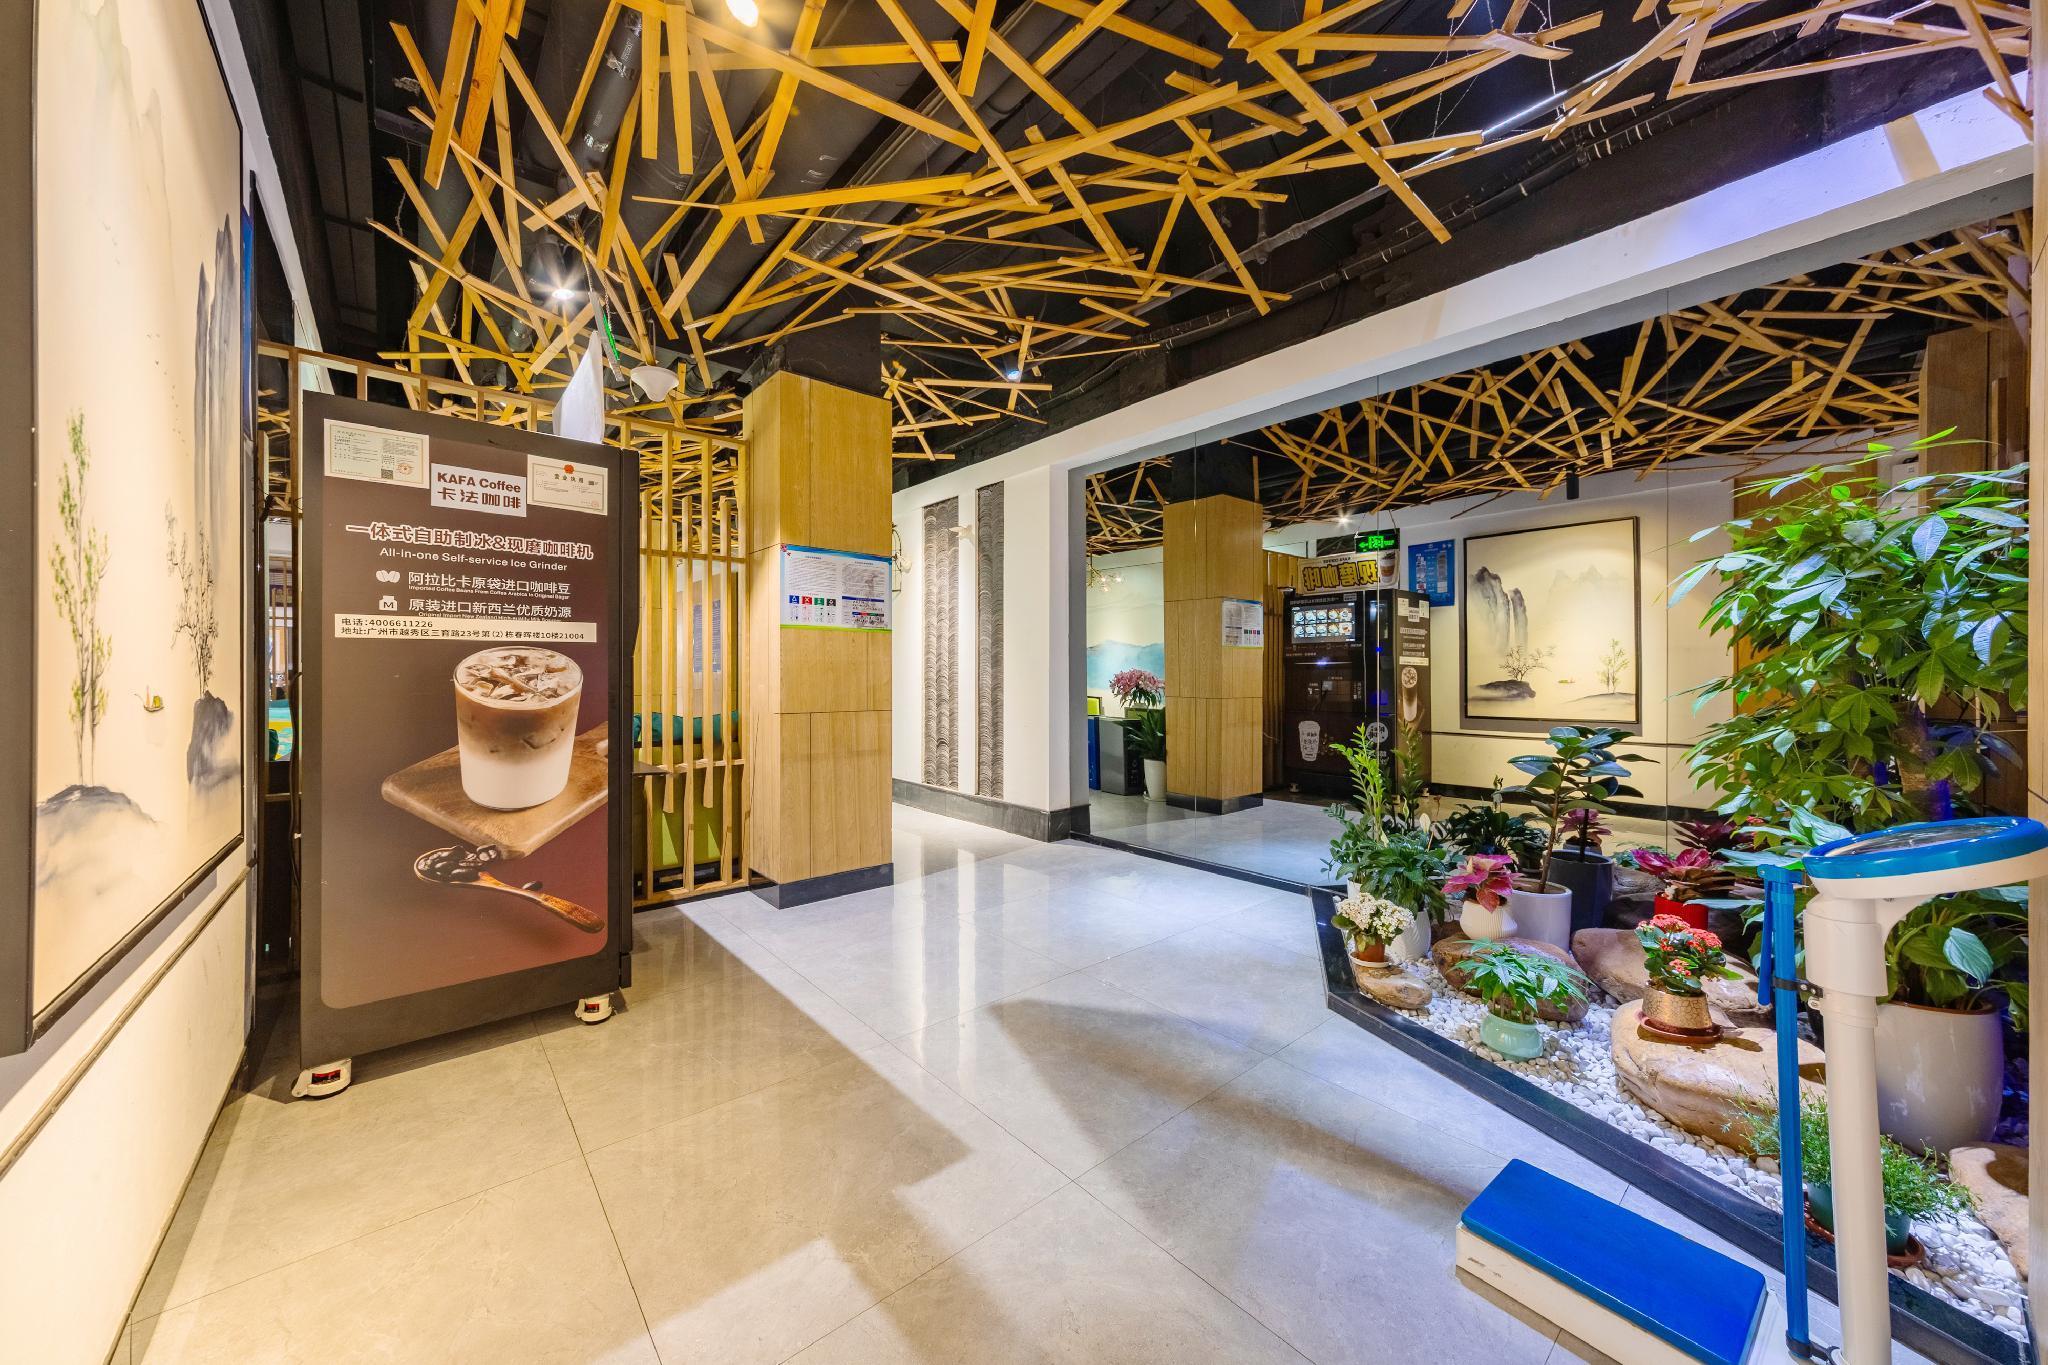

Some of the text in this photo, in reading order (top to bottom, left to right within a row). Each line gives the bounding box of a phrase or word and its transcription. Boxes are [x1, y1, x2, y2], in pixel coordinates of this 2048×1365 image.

[437, 472, 476, 487] KAFA
[479, 478, 521, 493] Coffee
[437, 486, 521, 509] 卡法咖啡
[346, 522, 594, 561] 一体式自助制冰&现磨咖啡机
[441, 552, 508, 567] Self-service
[511, 558, 527, 568] Ice
[529, 560, 568, 572] Grinder
[408, 571, 571, 595] 阿拉比卡原袋进口咖啡豆
[408, 598, 572, 618] 原装进口新西兰优质奶源
